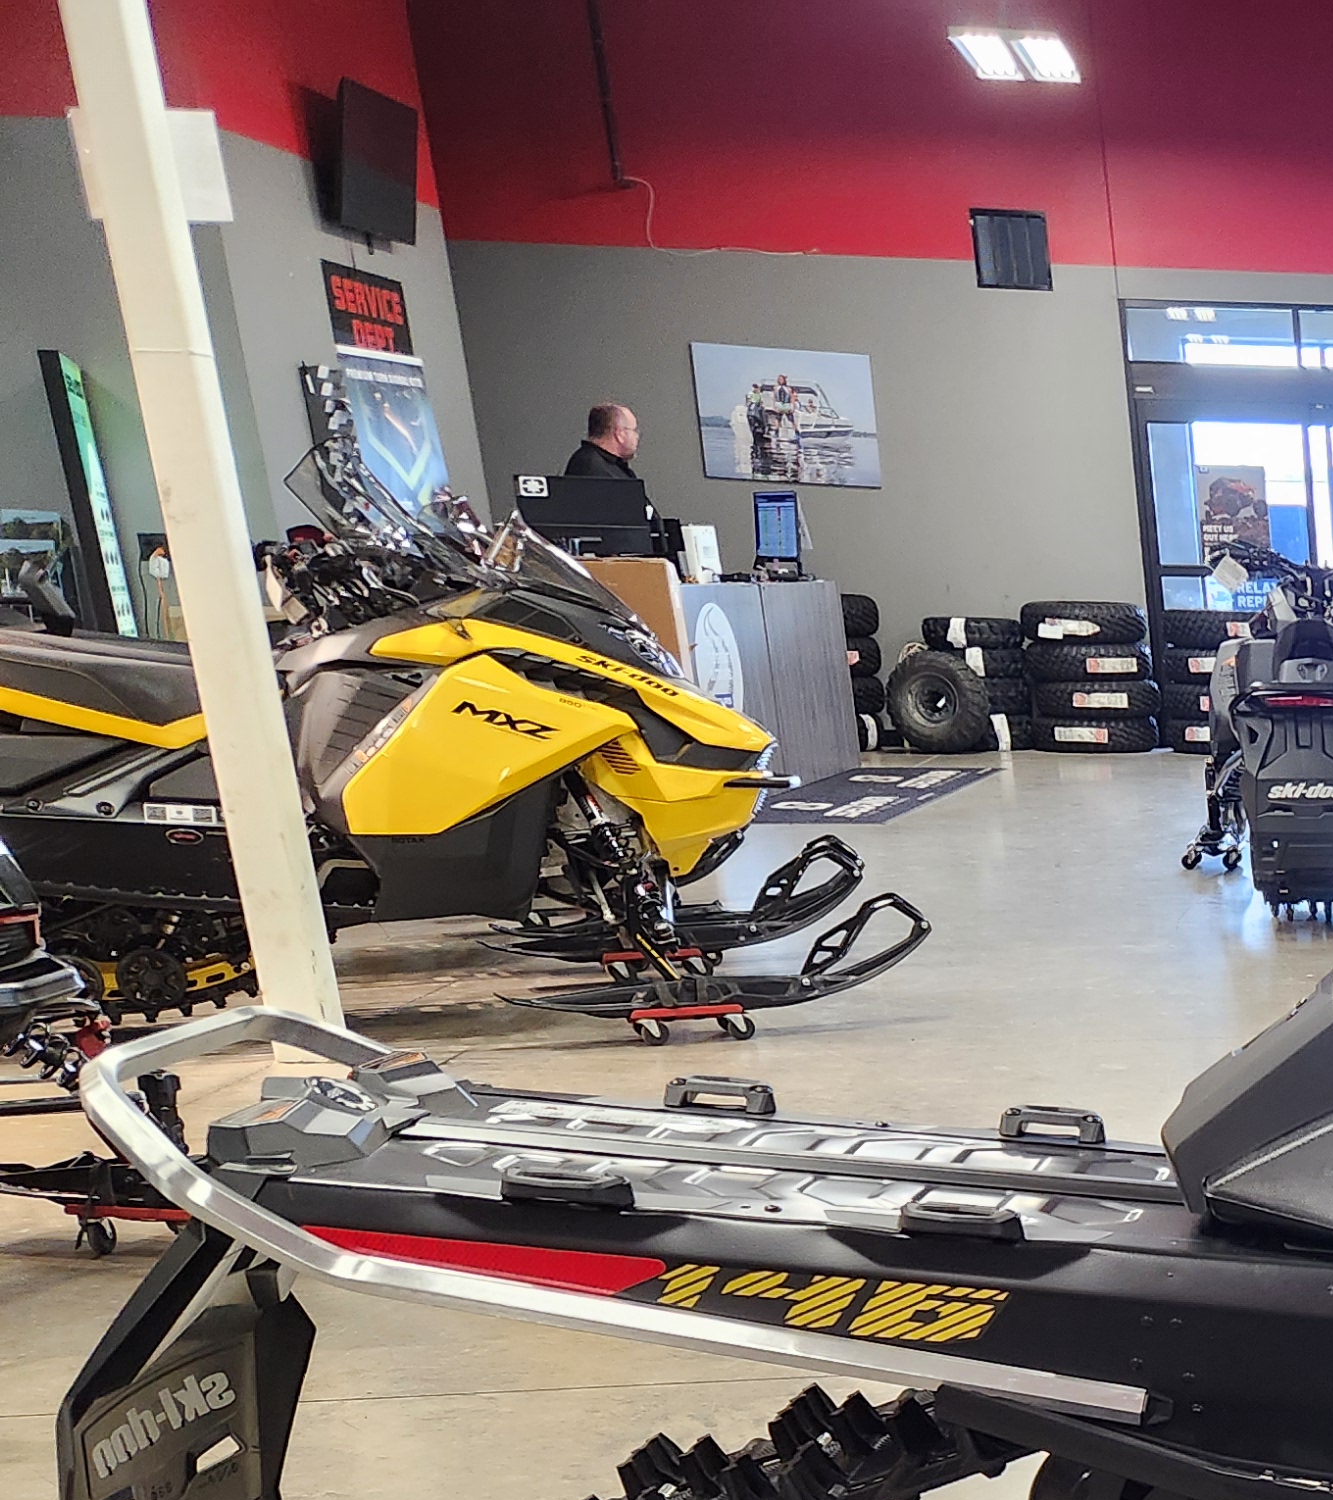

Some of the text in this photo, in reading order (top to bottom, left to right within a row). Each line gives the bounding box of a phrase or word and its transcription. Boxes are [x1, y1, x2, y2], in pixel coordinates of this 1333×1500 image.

[330, 274, 404, 325] SERVICE
[352, 320, 395, 352] DEPT
[575, 654, 680, 697] ski-doo
[451, 700, 561, 741] MXZ
[657, 1263, 1010, 1343] 146
